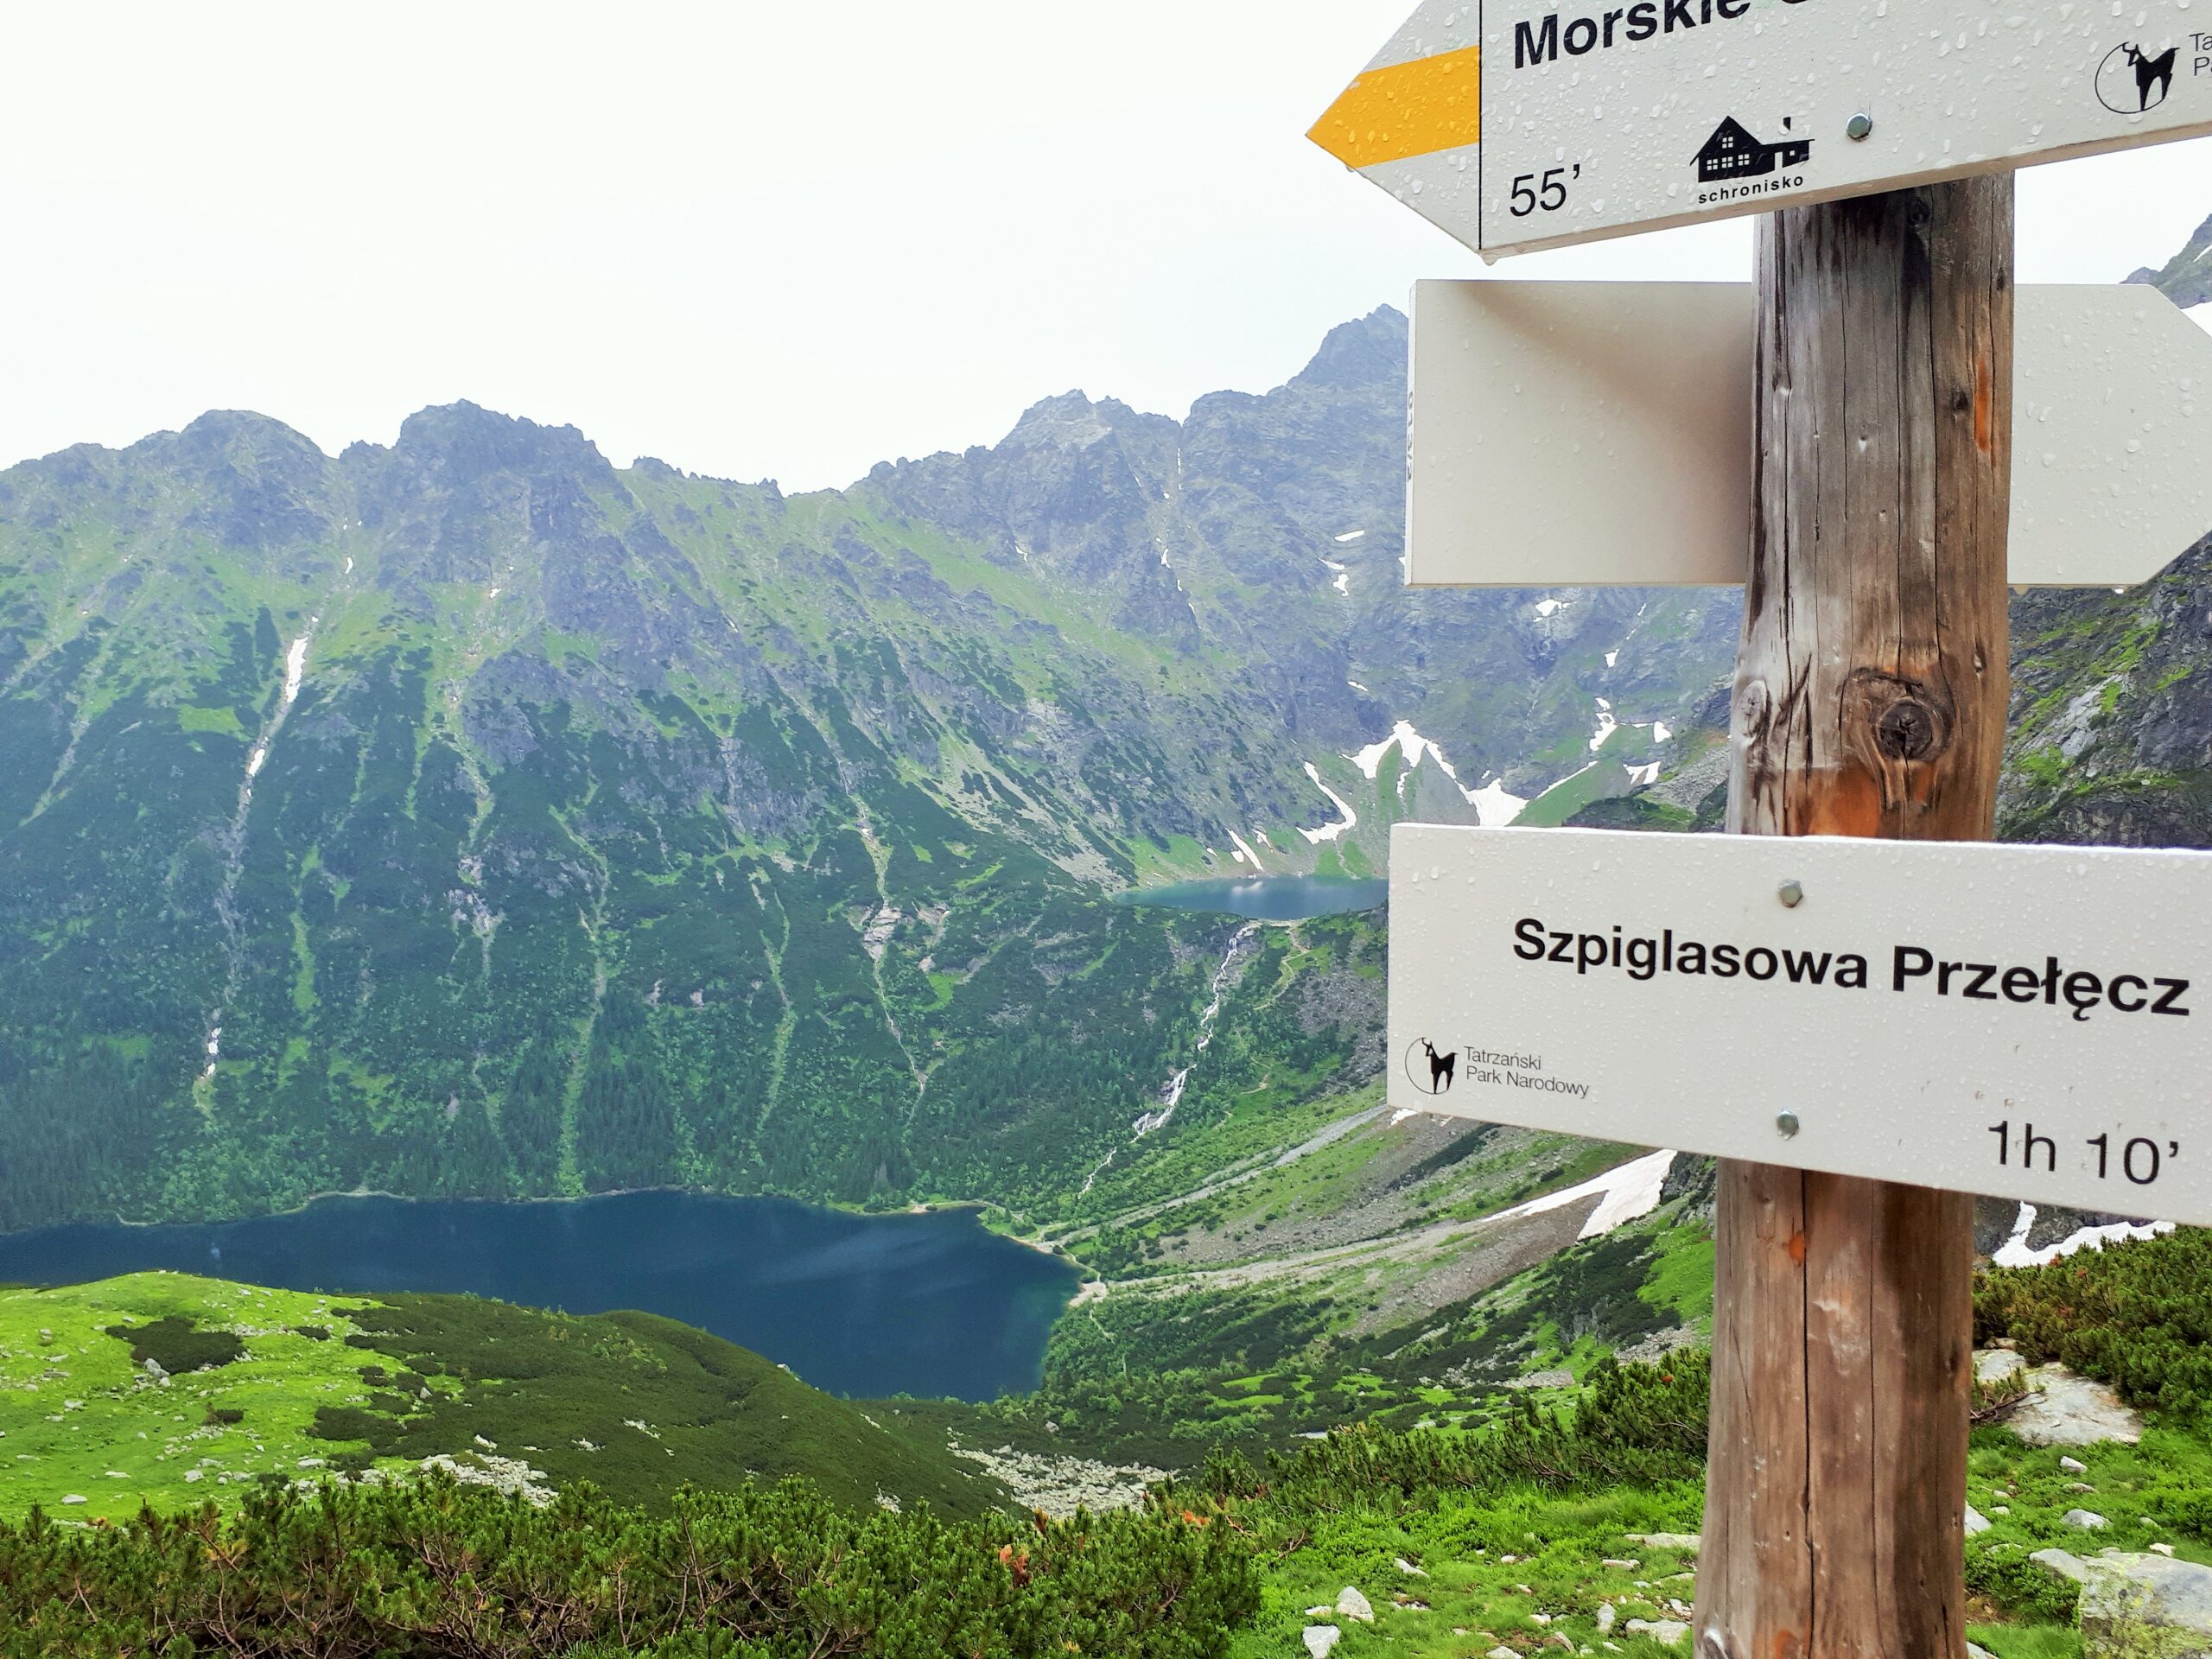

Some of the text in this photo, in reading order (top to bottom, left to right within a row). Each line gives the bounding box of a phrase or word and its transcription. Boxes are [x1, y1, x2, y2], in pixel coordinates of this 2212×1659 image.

[2194, 56, 2212, 77] P
[1698, 175, 1803, 204] schronisko
[1513, 918, 2190, 1022] Szpiglasowa Przełęcz
[1464, 1046, 1541, 1071] Tatrzański
[1466, 1065, 1589, 1099] Park Narodowy
[1988, 1120, 2056, 1172] 1h
